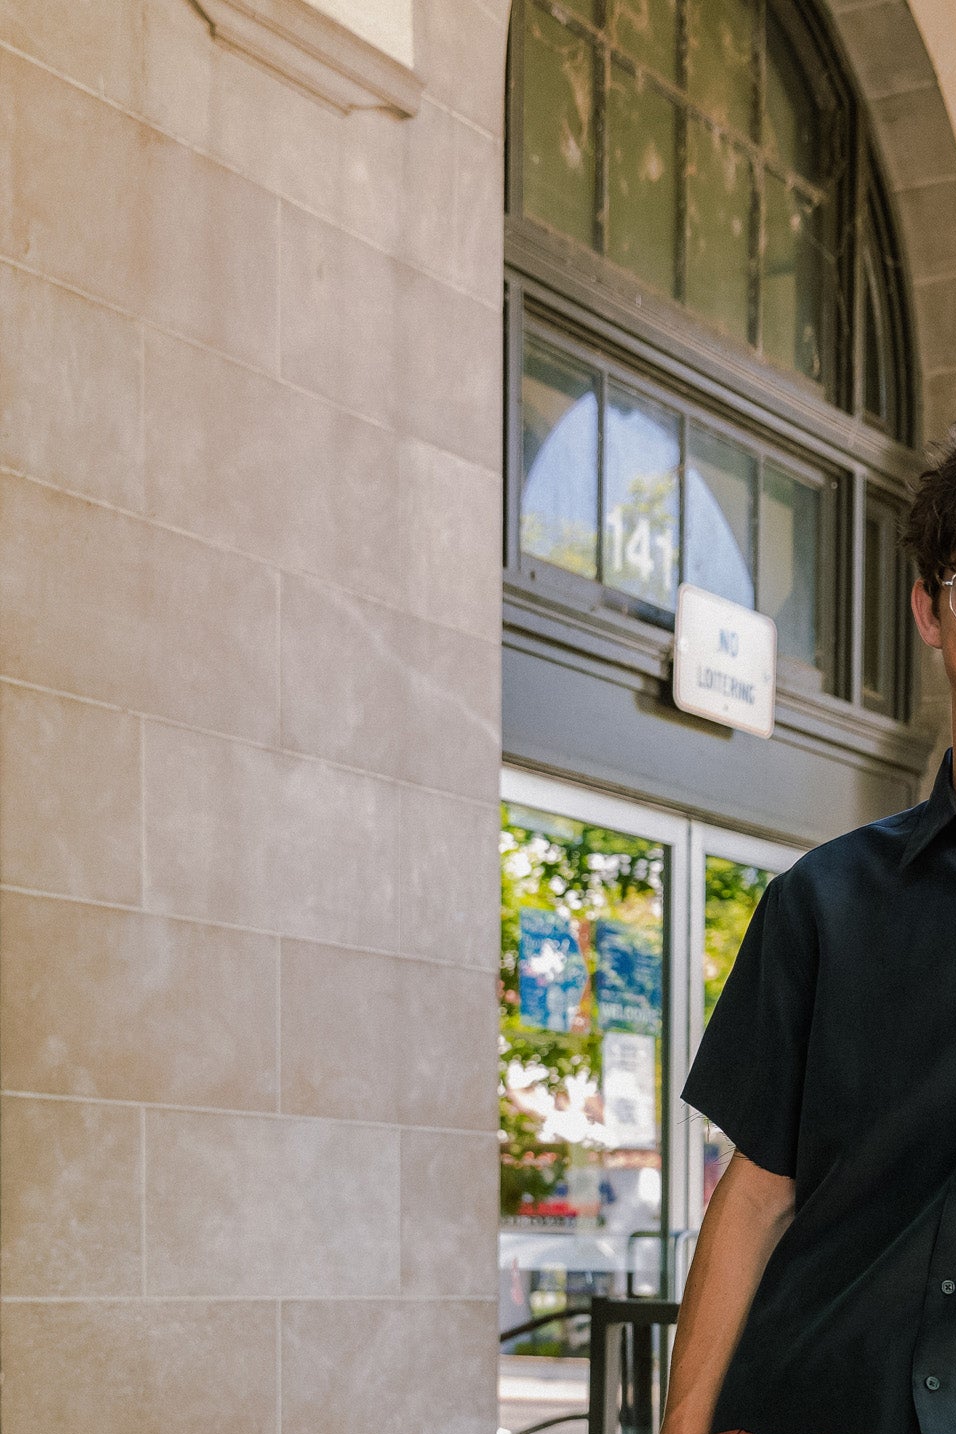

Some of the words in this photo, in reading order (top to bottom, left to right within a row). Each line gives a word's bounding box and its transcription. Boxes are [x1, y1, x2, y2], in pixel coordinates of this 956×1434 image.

[607, 507, 673, 592] 141
[719, 628, 738, 656] NO
[697, 665, 755, 704] LOITERING
